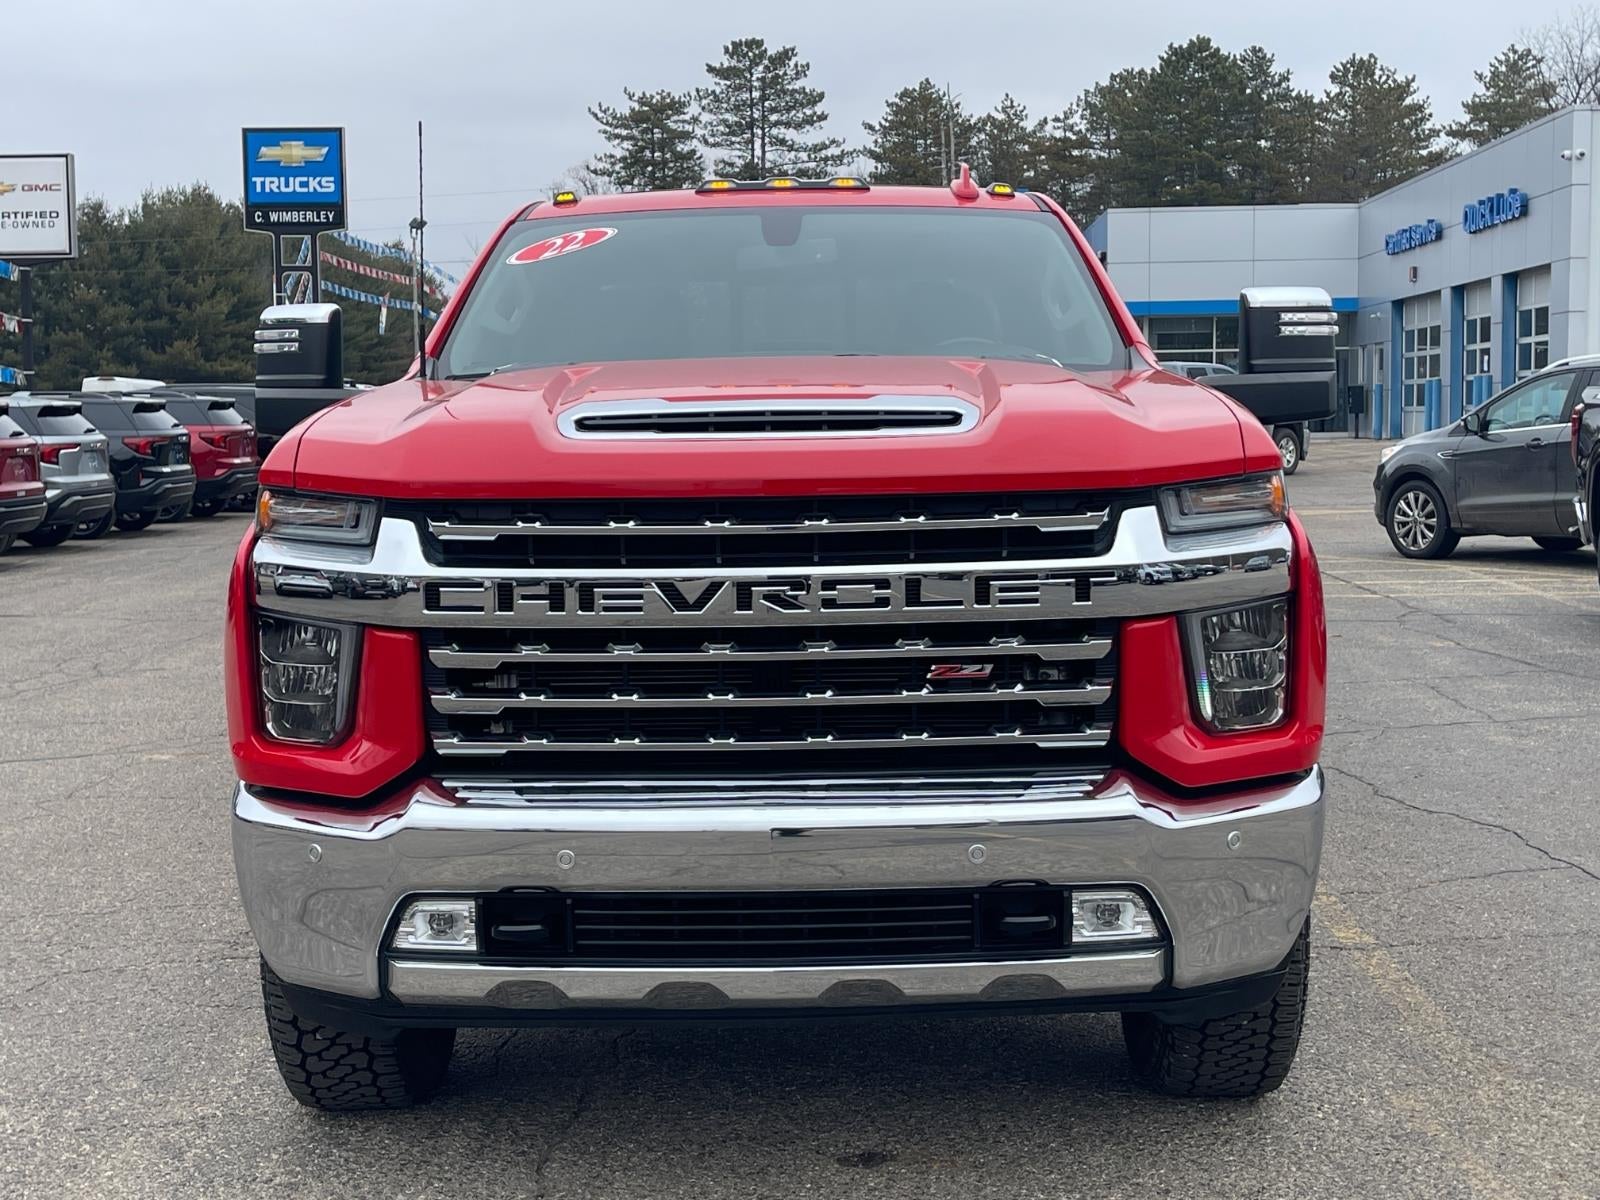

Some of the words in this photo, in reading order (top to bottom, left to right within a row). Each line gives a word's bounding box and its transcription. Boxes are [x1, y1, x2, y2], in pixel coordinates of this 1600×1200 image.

[21, 184, 62, 192] GMC
[251, 176, 336, 193] TRUCKS
[254, 211, 265, 223] C.
[268, 211, 335, 223] WIMBERLEY
[1463, 198, 1491, 234] Quick
[1493, 188, 1528, 224] Lube
[539, 231, 586, 260] 22
[423, 570, 1117, 615] CHEVROLET
